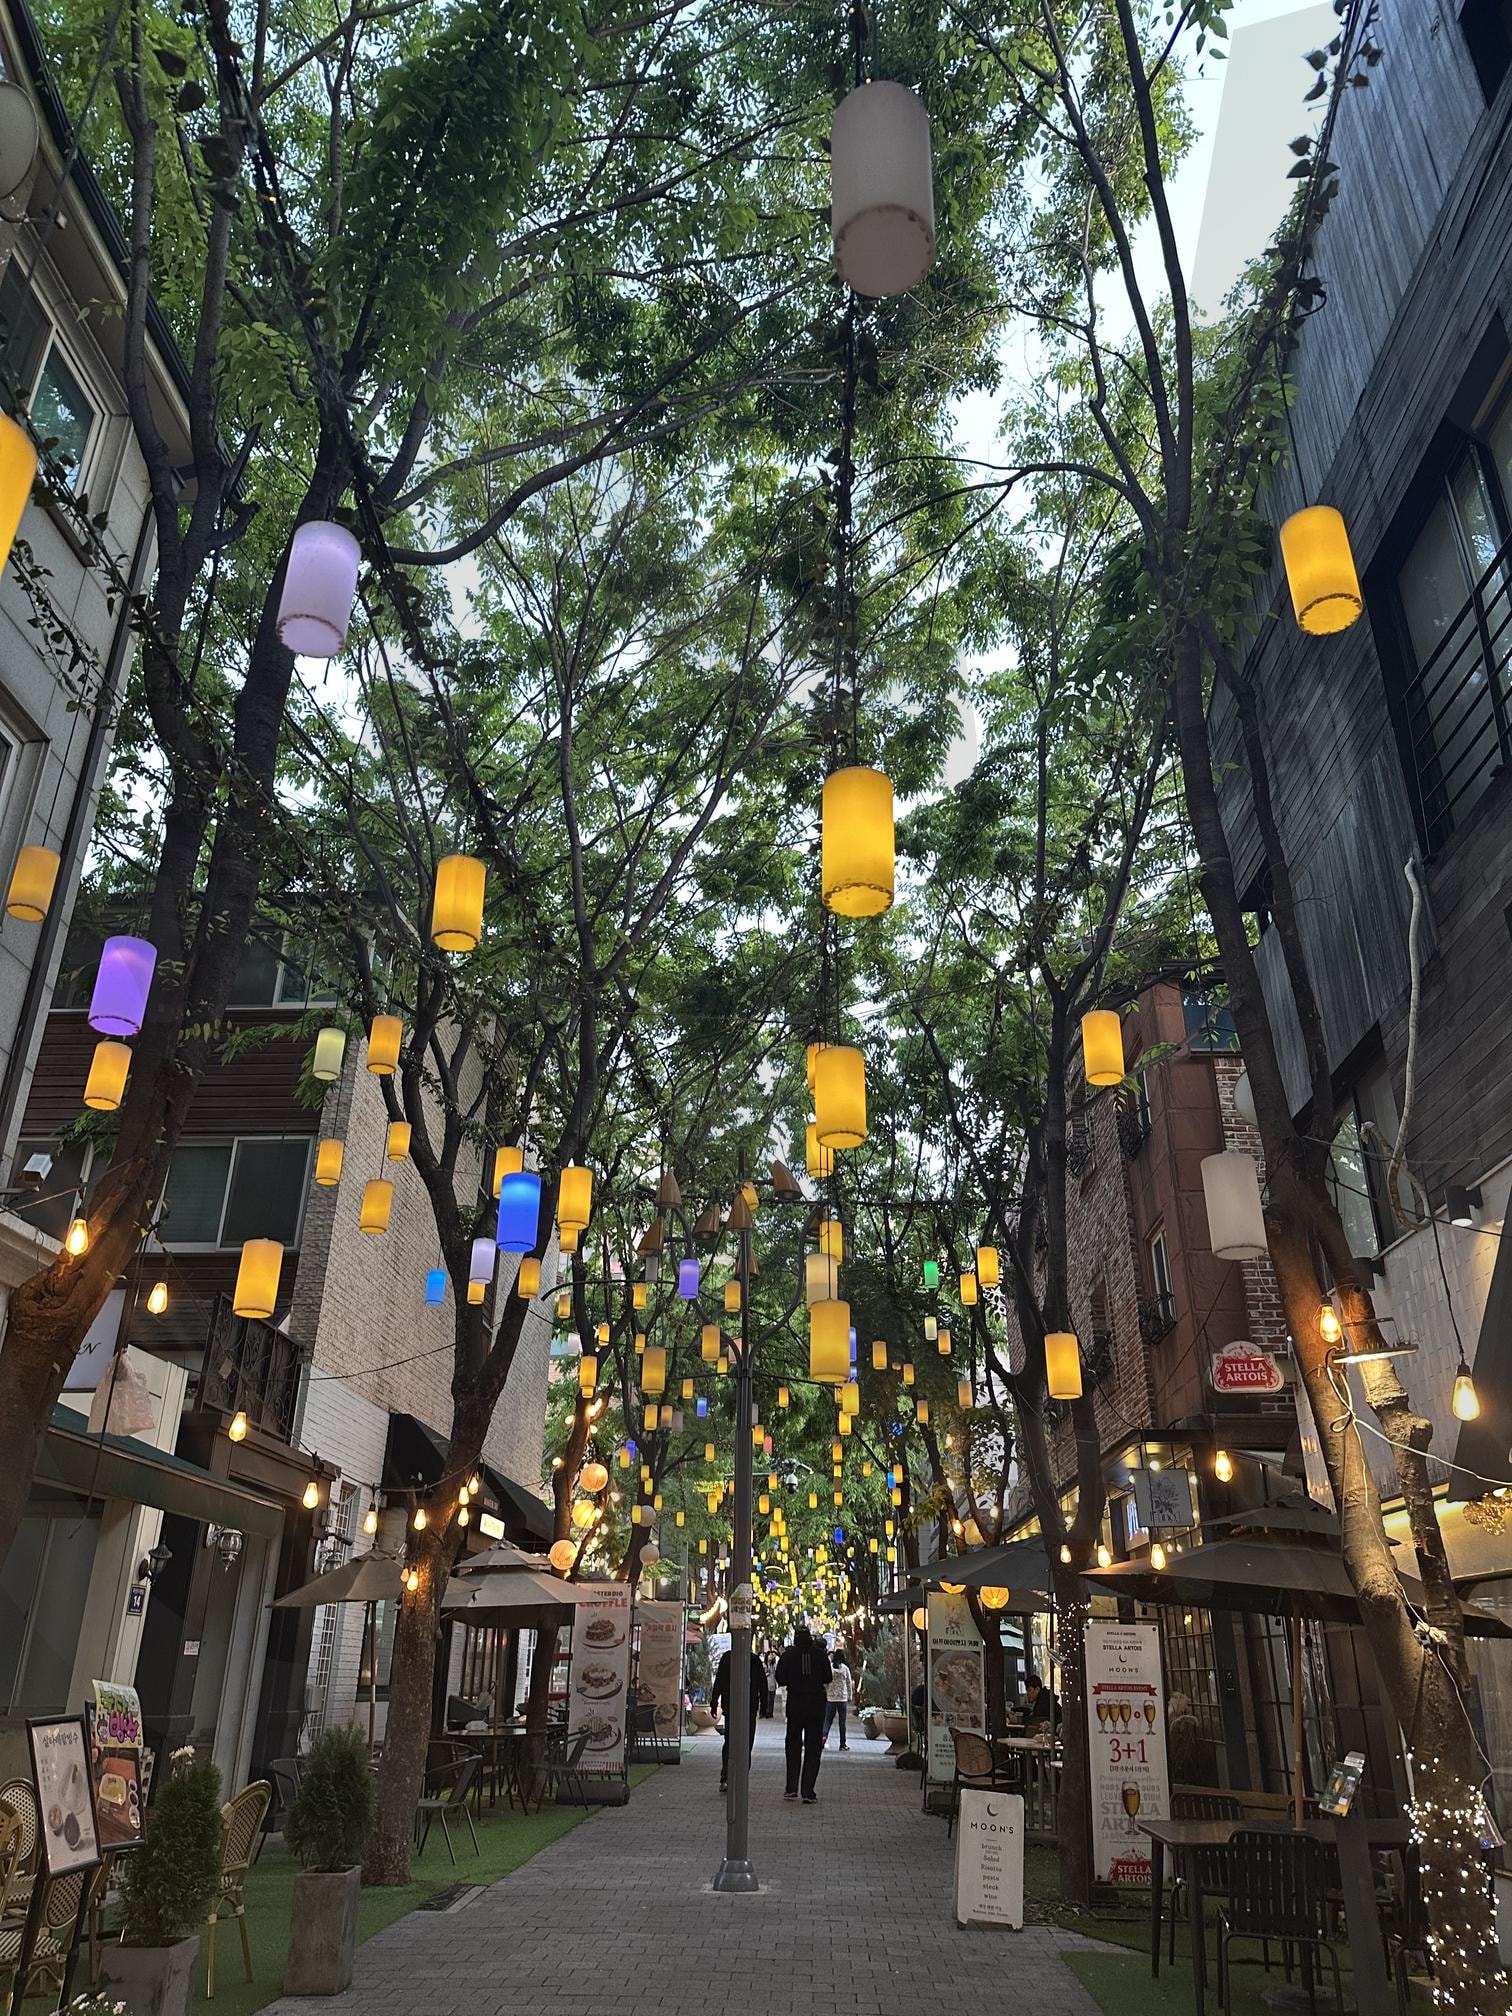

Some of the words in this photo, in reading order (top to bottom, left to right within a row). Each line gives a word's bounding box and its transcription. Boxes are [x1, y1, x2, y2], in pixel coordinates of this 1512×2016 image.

[1224, 1362, 1266, 1373] STELLA
[1226, 1372, 1268, 1382] ARTOIS
[133, 1595, 141, 1607] 14
[1109, 1738, 1148, 1763] 3+1
[970, 1821, 1014, 1834] MOON'S
[1117, 1865, 1152, 1874] STELLA
